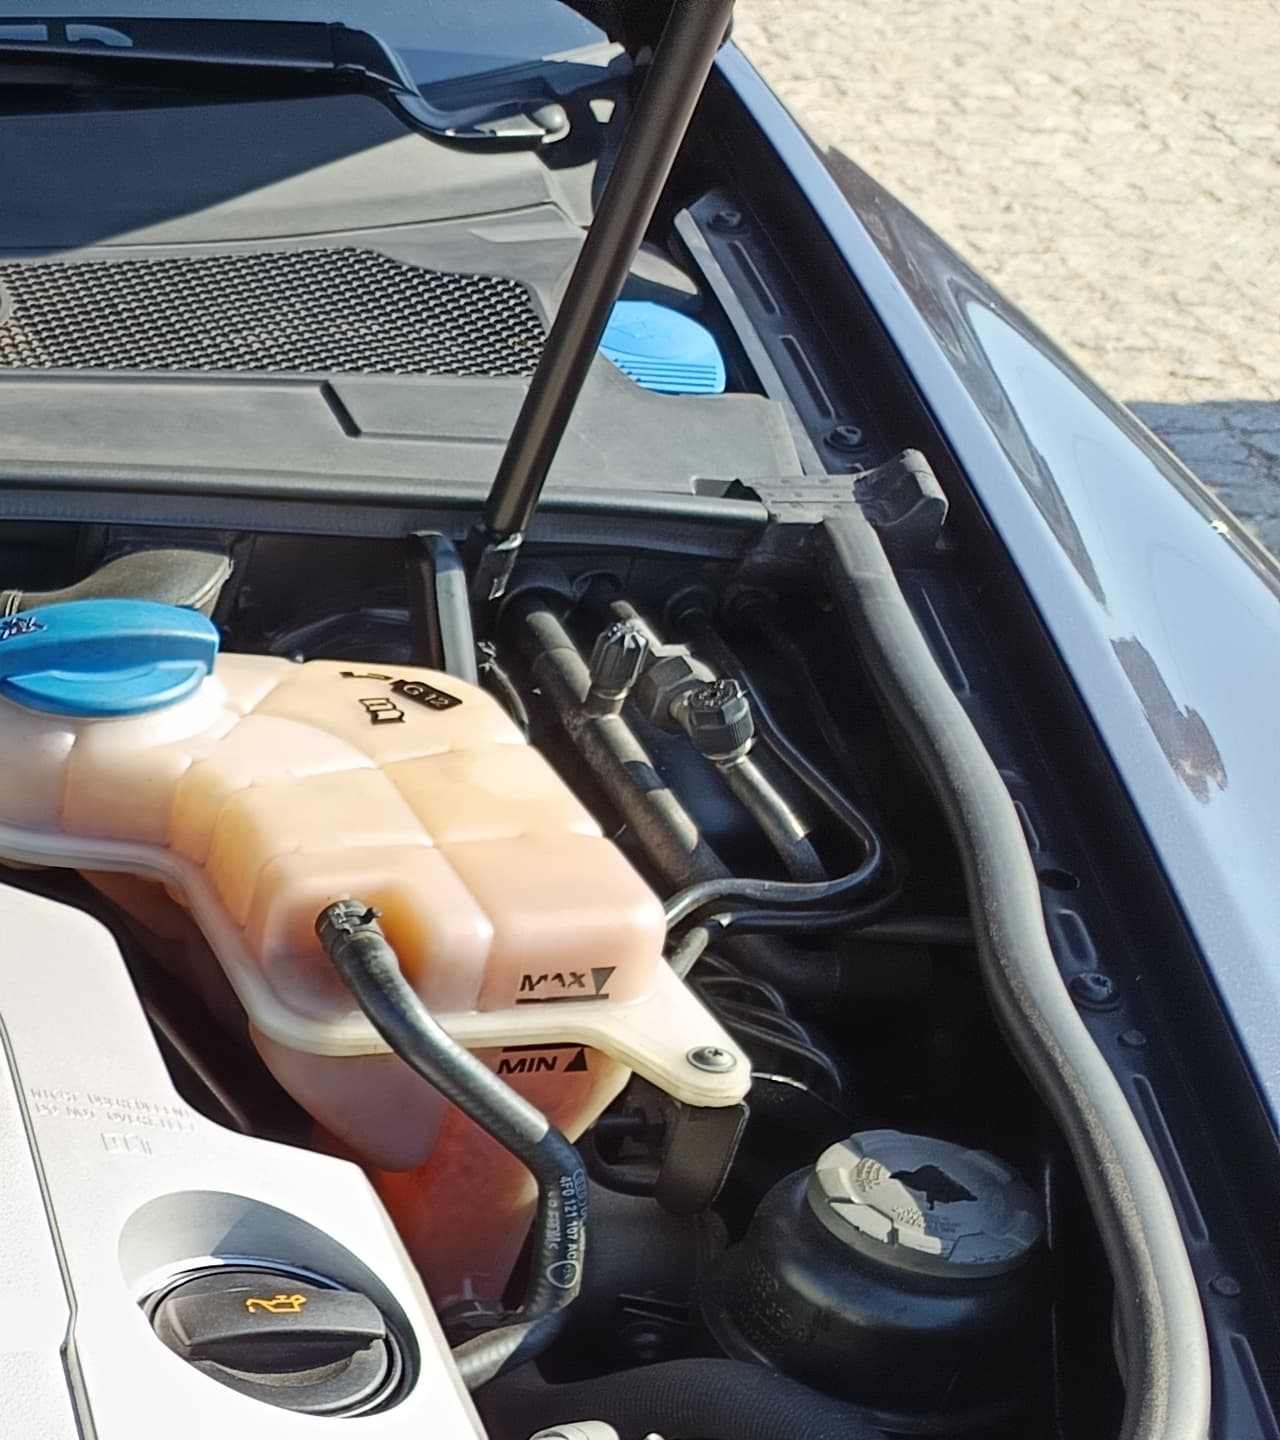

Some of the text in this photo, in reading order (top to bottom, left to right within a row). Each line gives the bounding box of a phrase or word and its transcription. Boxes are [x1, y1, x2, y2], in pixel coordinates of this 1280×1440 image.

[519, 972, 587, 992] MAX
[497, 1056, 558, 1074] MIN
[559, 1175, 573, 1196] 4F0
[563, 1198, 578, 1218] 121
[566, 1221, 579, 1240] 107
